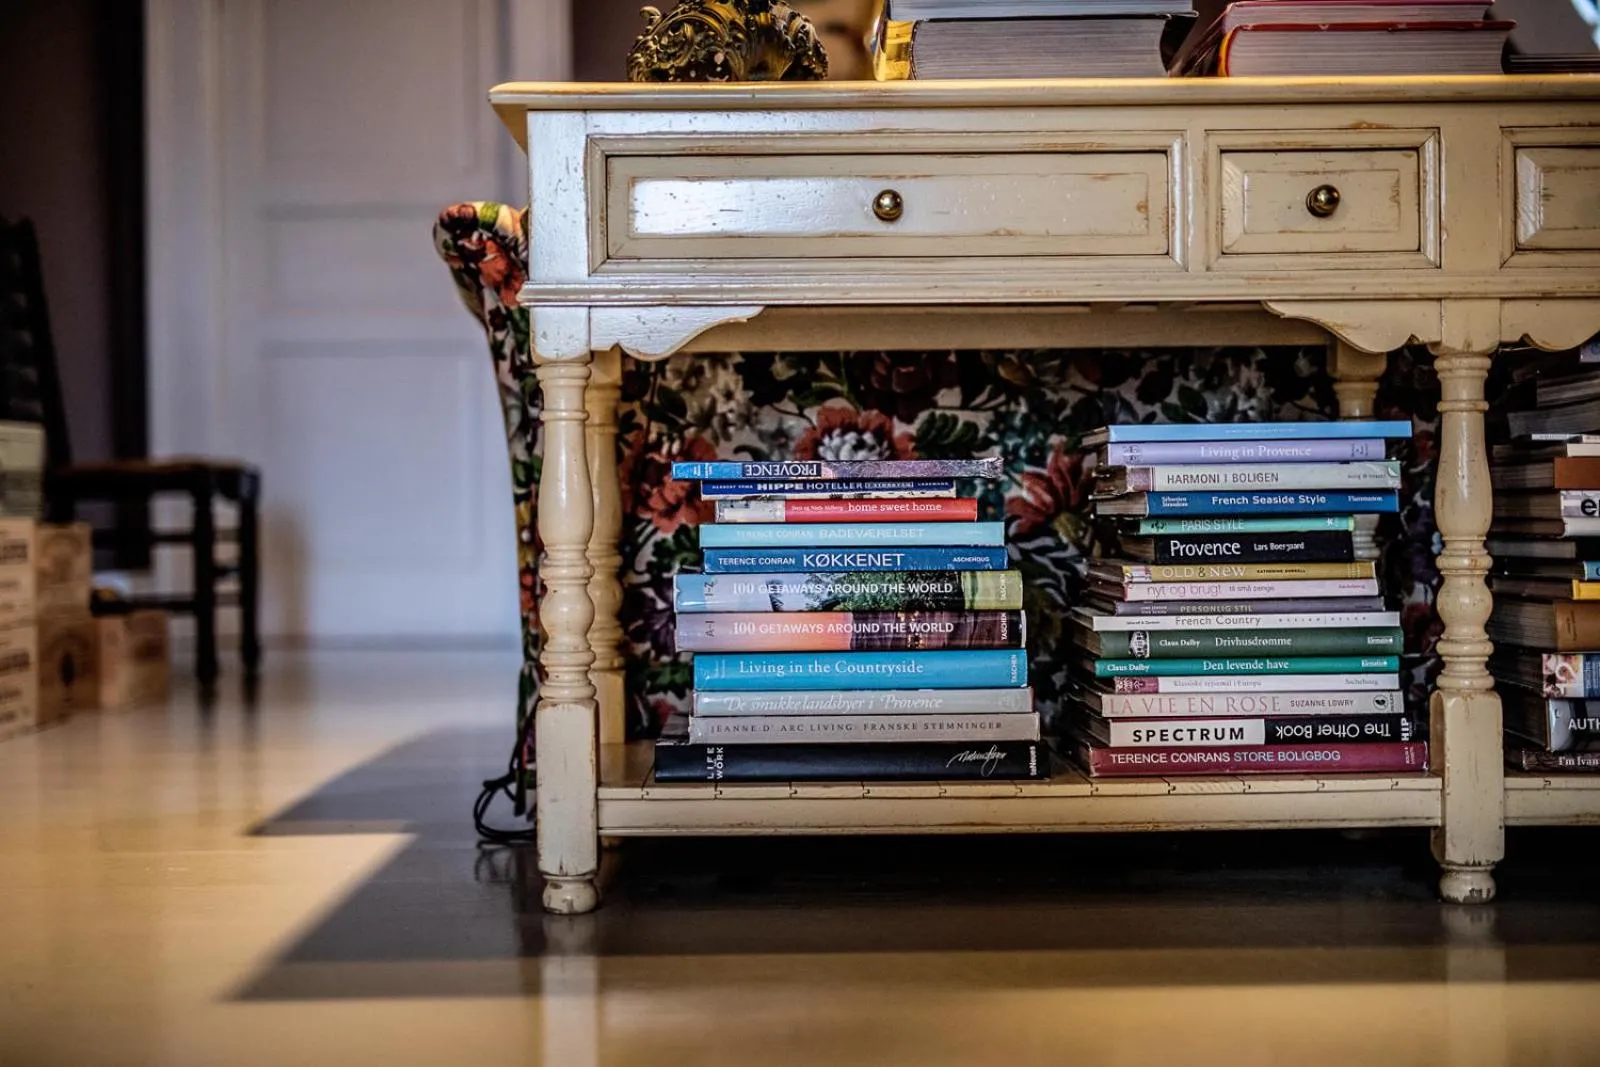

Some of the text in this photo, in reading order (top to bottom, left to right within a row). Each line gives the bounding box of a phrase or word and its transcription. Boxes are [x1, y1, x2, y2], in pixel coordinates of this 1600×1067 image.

[1200, 444, 1312, 461] Living in Provence
[745, 464, 818, 477] PROVENCE
[1167, 472, 1279, 485] HARMONI I BOLIGEN
[756, 482, 804, 491] HIPPE
[806, 481, 863, 490] HOTELLER
[1211, 494, 1327, 506] French Seaside Style
[848, 502, 942, 512] home sweet home
[1181, 519, 1245, 531] PARIS STYLE
[776, 529, 815, 539] CONRAN
[819, 528, 926, 540] BADEVÆRELSET
[1169, 540, 1242, 557] Provence
[1253, 543, 1269, 551] Lars
[718, 557, 796, 566] TERENCE CONRAN
[803, 553, 905, 568] KØKKENET
[1162, 566, 1195, 578] OLD
[1198, 566, 1206, 578] &
[732, 582, 953, 595] 100 GETAWAYS AROUND THE WORLD
[1147, 585, 1167, 598] nyt
[1169, 586, 1186, 598] og
[1179, 603, 1253, 613] PERSONLIG STIL
[1175, 615, 1262, 627] French Country
[733, 622, 954, 635] 100 GETAWAYS AROUND THE WORLD
[1158, 638, 1201, 648] Claus Dalby
[1214, 636, 1293, 648] Drivhusdrømme
[739, 659, 924, 678] Living in the Countryside
[1106, 663, 1150, 673] Claus Dalby
[1203, 658, 1289, 671] Den levende have
[880, 694, 943, 710] Provence
[1109, 695, 1281, 715] LA VIE EN ROSE
[1289, 699, 1354, 708] SUZANNE LOWRY
[710, 723, 756, 733] JEANNE
[780, 723, 805, 732] ARC
[810, 722, 854, 732] LIVING
[863, 722, 918, 731] FRANSKE
[923, 721, 1003, 730] STEMNINGER
[1275, 724, 1313, 740] Book
[1317, 722, 1360, 738] Other
[1364, 722, 1391, 738] The
[1401, 717, 1410, 741] HIP
[1132, 727, 1245, 743] SPECTRUM
[706, 747, 715, 779] LIFE
[716, 746, 724, 780] WORK
[1110, 750, 1341, 764] TERENCE CONRANS STORE BOLIGBOG
